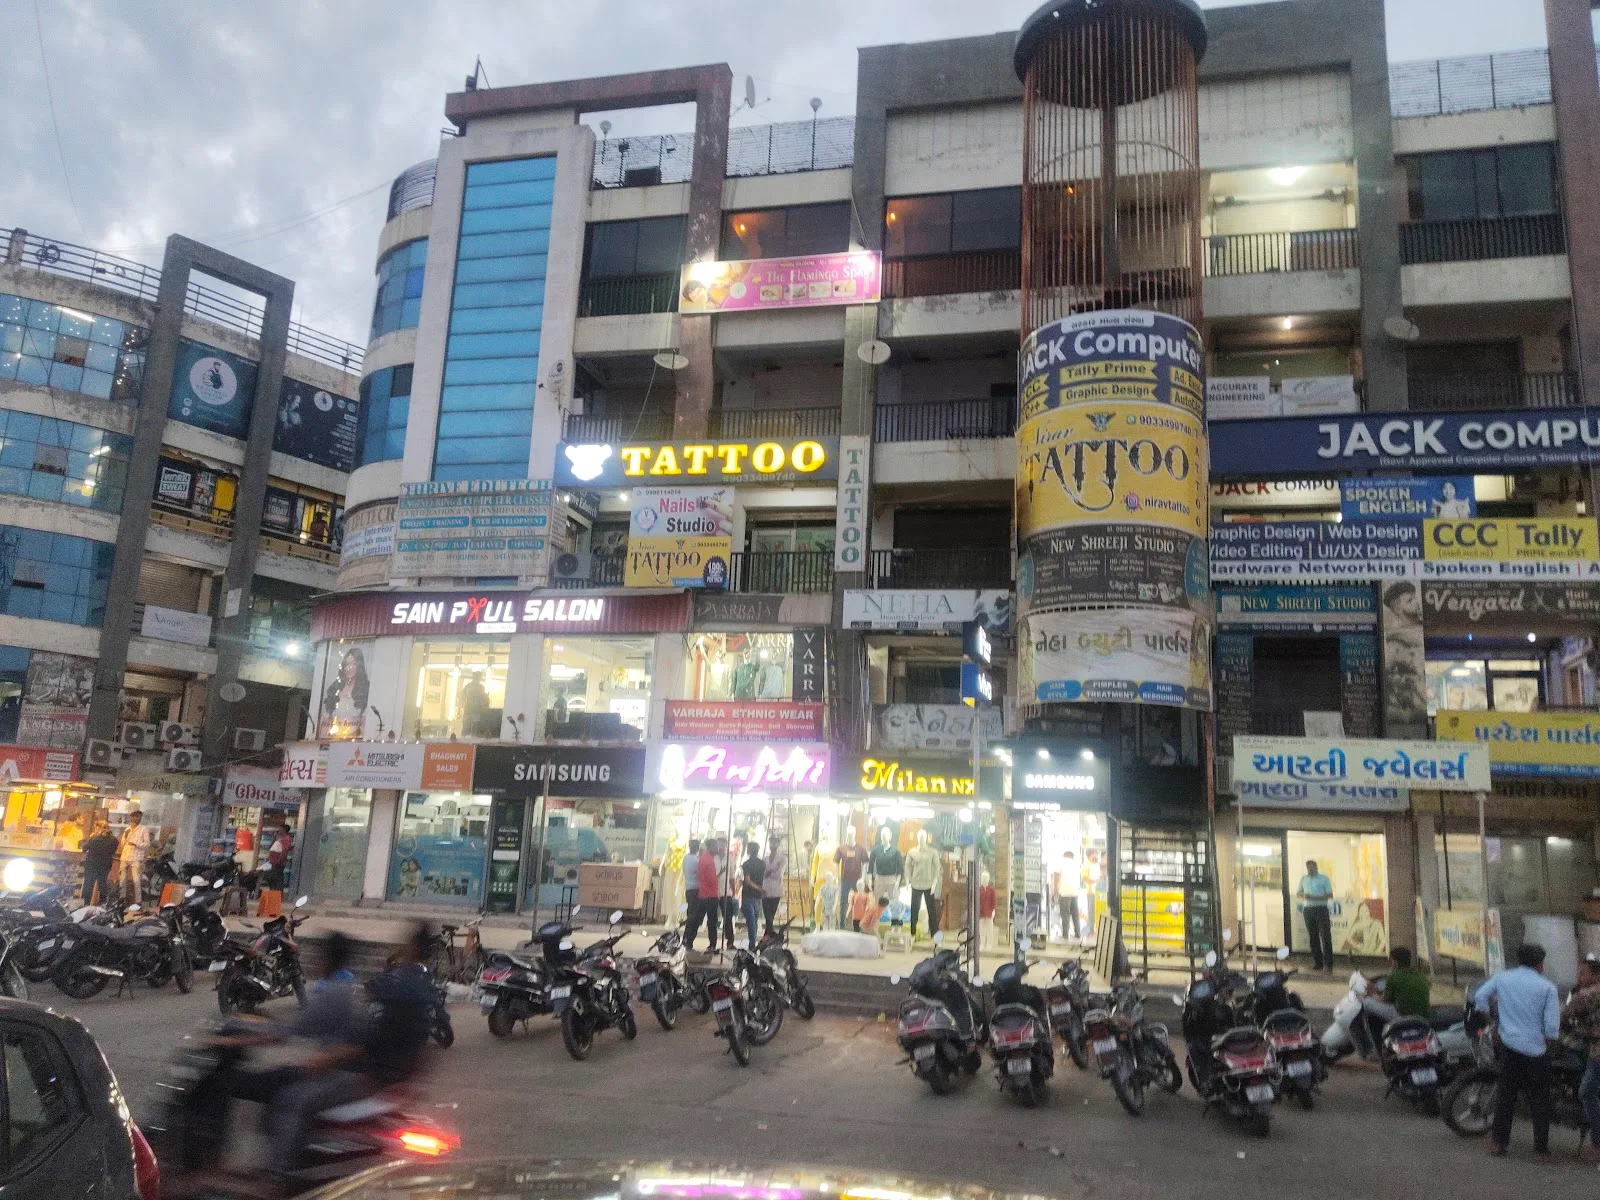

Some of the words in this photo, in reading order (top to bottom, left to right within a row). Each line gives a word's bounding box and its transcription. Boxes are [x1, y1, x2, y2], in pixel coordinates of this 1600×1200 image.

[1074, 329, 1201, 374] Computer
[1066, 365, 1099, 379] Tally
[1104, 363, 1146, 375] Prime
[1066, 384, 1108, 400] Graphic
[1112, 383, 1150, 397] Design
[1210, 383, 1259, 392] ACCURATE
[1208, 393, 1266, 402] NGINEERING
[1317, 419, 1448, 459] JACK
[622, 440, 826, 477] TATTOO
[1410, 455, 1454, 466] Approved
[1456, 454, 1501, 464] Computer
[1541, 452, 1578, 463] Training
[1214, 481, 1271, 496] JACK
[1346, 487, 1411, 501] SPOKEN
[660, 498, 695, 513] Nails
[841, 449, 864, 564] TATTOO
[1359, 501, 1427, 514] ENGLISH
[666, 517, 715, 533] Studio
[1264, 525, 1316, 541] Design
[1328, 525, 1362, 539] Web
[1365, 525, 1418, 541] Design
[1433, 522, 1498, 547] CCC
[1516, 523, 1584, 550] Tally
[1051, 538, 1076, 555] NEW
[1081, 535, 1128, 553] SHREEJI
[1134, 535, 1175, 554] STUDIO
[1251, 544, 1304, 560] Editing
[1318, 544, 1363, 558] UI/UX
[1367, 544, 1420, 560] Design
[630, 551, 701, 585] TATTOO
[1299, 562, 1407, 577] Networking
[1423, 562, 1492, 577] Spoken
[1499, 562, 1570, 577] English
[1243, 595, 1270, 609] NEW
[1277, 595, 1321, 611] SHREEJI
[1327, 594, 1371, 610] STUDIO
[391, 602, 444, 624] SAIN
[522, 598, 604, 622] SALON
[1092, 681, 1128, 690] PIMPLES
[1156, 684, 1173, 693] HAIR
[1086, 690, 1135, 699] TREATMENT
[673, 708, 726, 719] VARRAJA
[732, 709, 776, 720] ETHNIC
[779, 709, 814, 720] WEAR
[367, 752, 406, 760] MITSUBISHI
[430, 752, 468, 761] BHAGWATI
[436, 764, 460, 773] SALES
[514, 763, 611, 782] SAMSUNG
[1252, 747, 1348, 783] આરતી
[358, 775, 402, 784] CONDITIONERS
[861, 758, 947, 795] Milan
[1025, 773, 1095, 791] SAMSUNG
